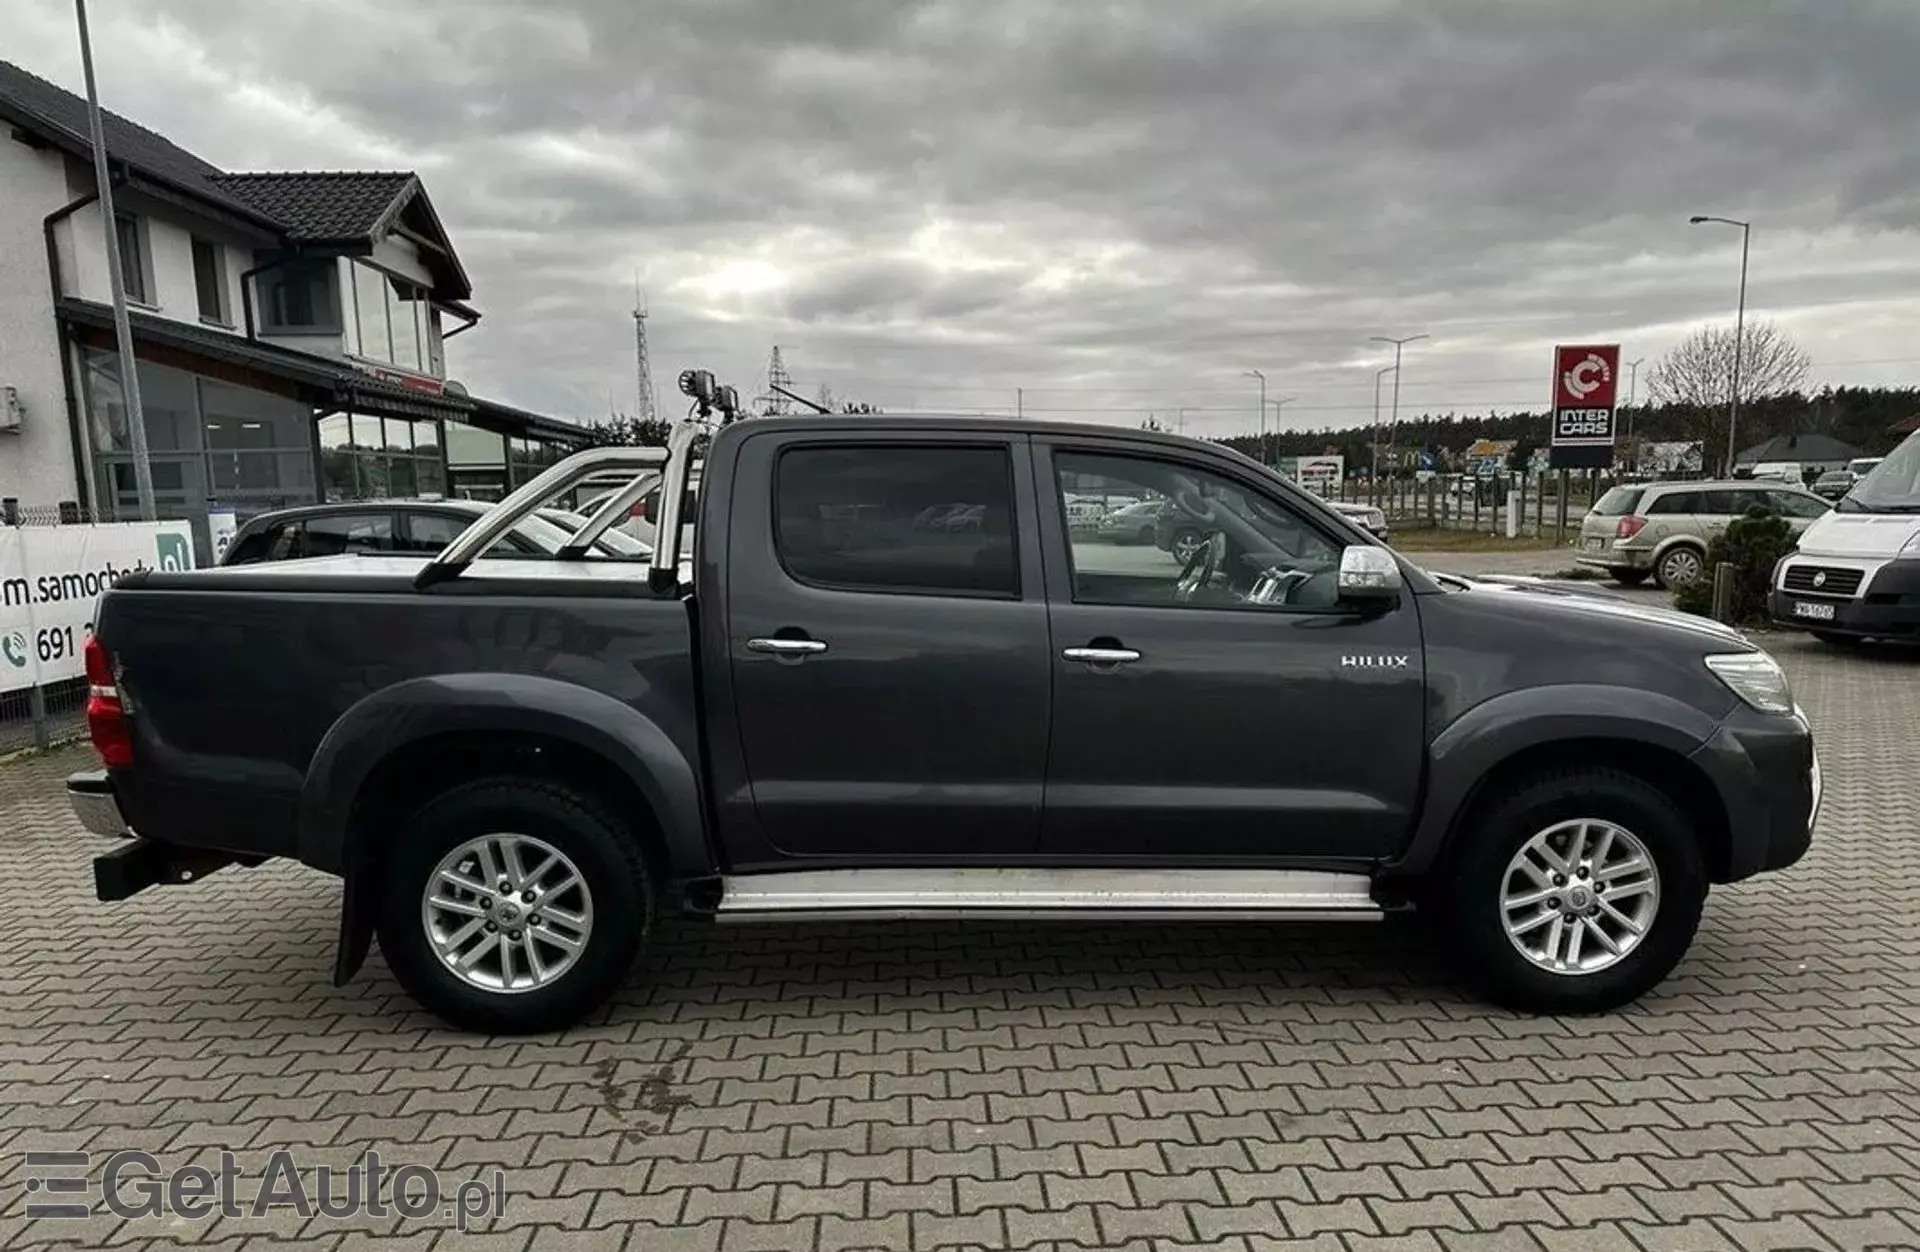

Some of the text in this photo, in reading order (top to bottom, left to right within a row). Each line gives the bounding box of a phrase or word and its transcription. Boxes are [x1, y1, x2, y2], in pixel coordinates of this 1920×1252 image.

[1560, 409, 1609, 421] INTER
[1560, 422, 1608, 435] CARS
[37, 626, 74, 662] 691
[1341, 655, 1408, 668] HILUX
